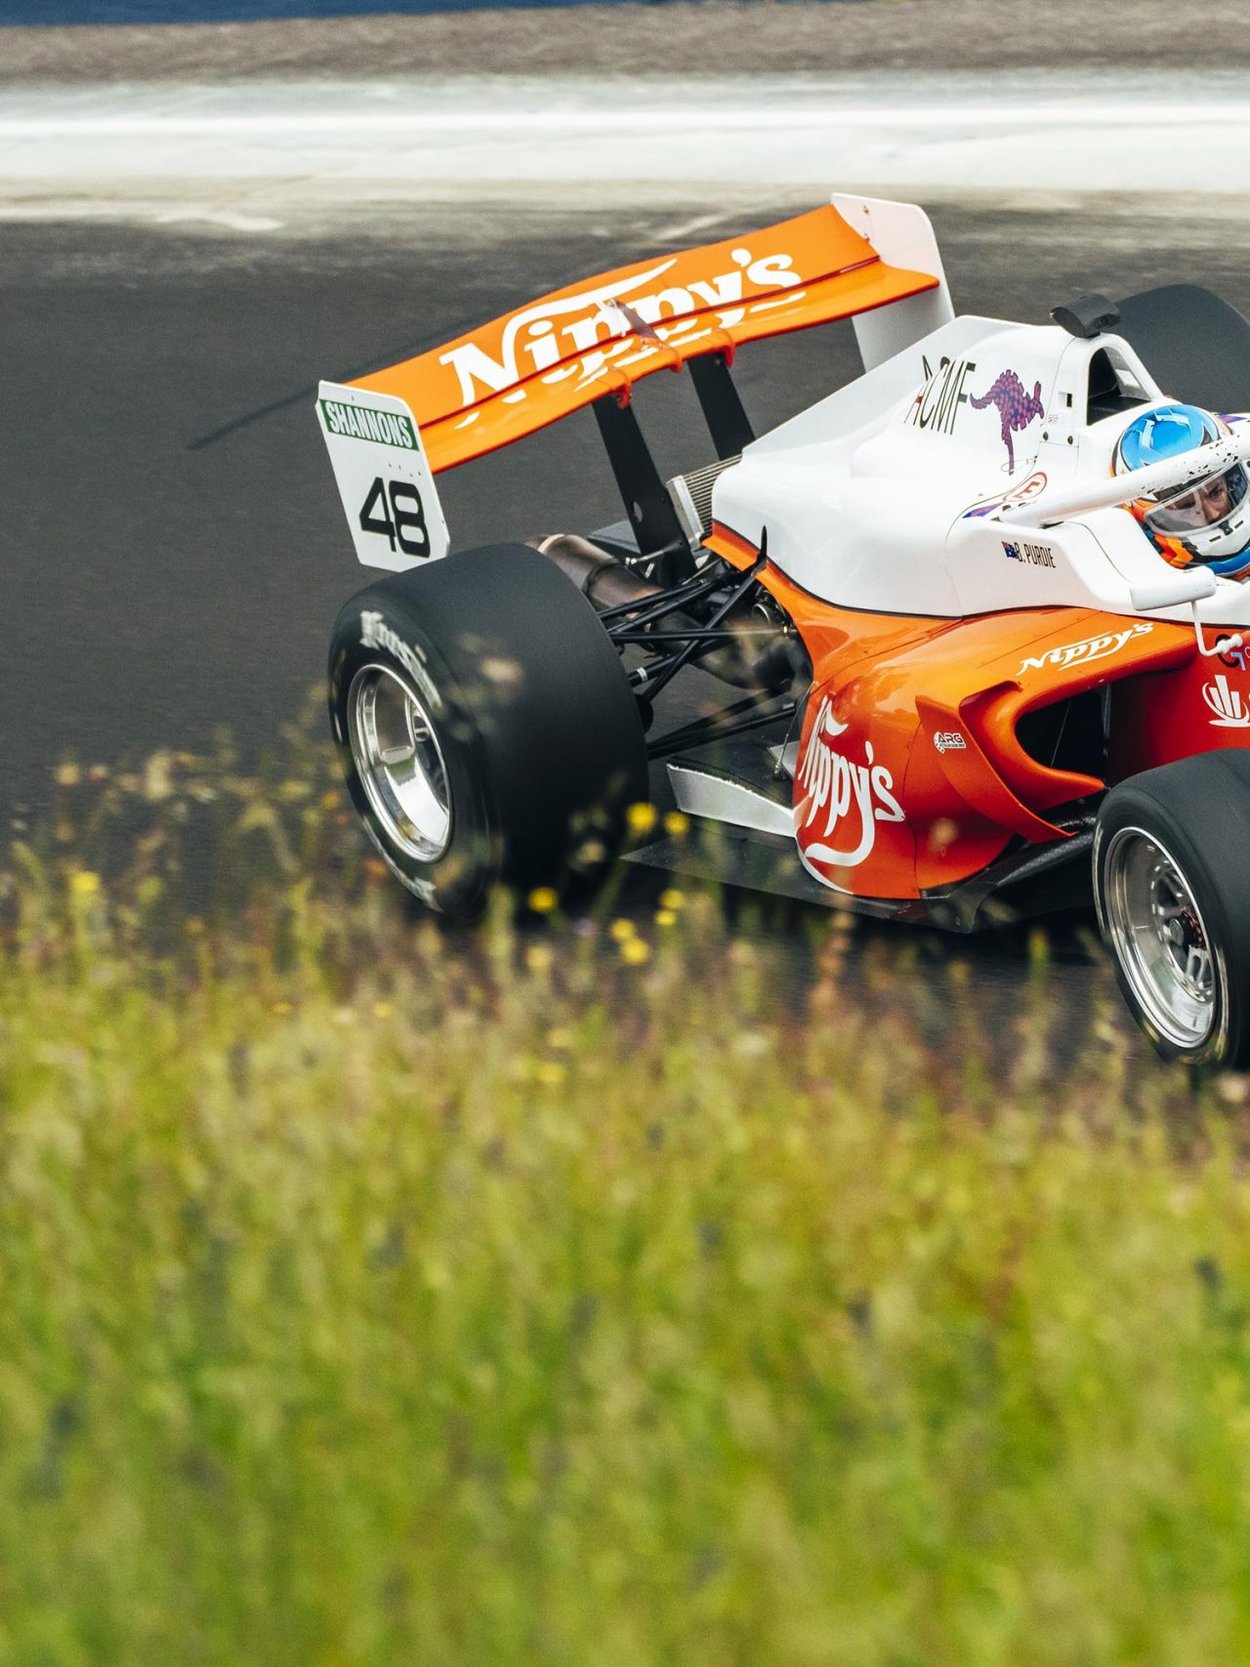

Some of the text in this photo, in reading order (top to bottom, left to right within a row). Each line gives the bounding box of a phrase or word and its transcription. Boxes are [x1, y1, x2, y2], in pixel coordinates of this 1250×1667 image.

[325, 401, 414, 449] SHANNONS
[359, 476, 431, 559] 48
[1023, 543, 1056, 569] PURDIE
[1015, 622, 1154, 677] Nippy's
[938, 733, 964, 744] ARG
